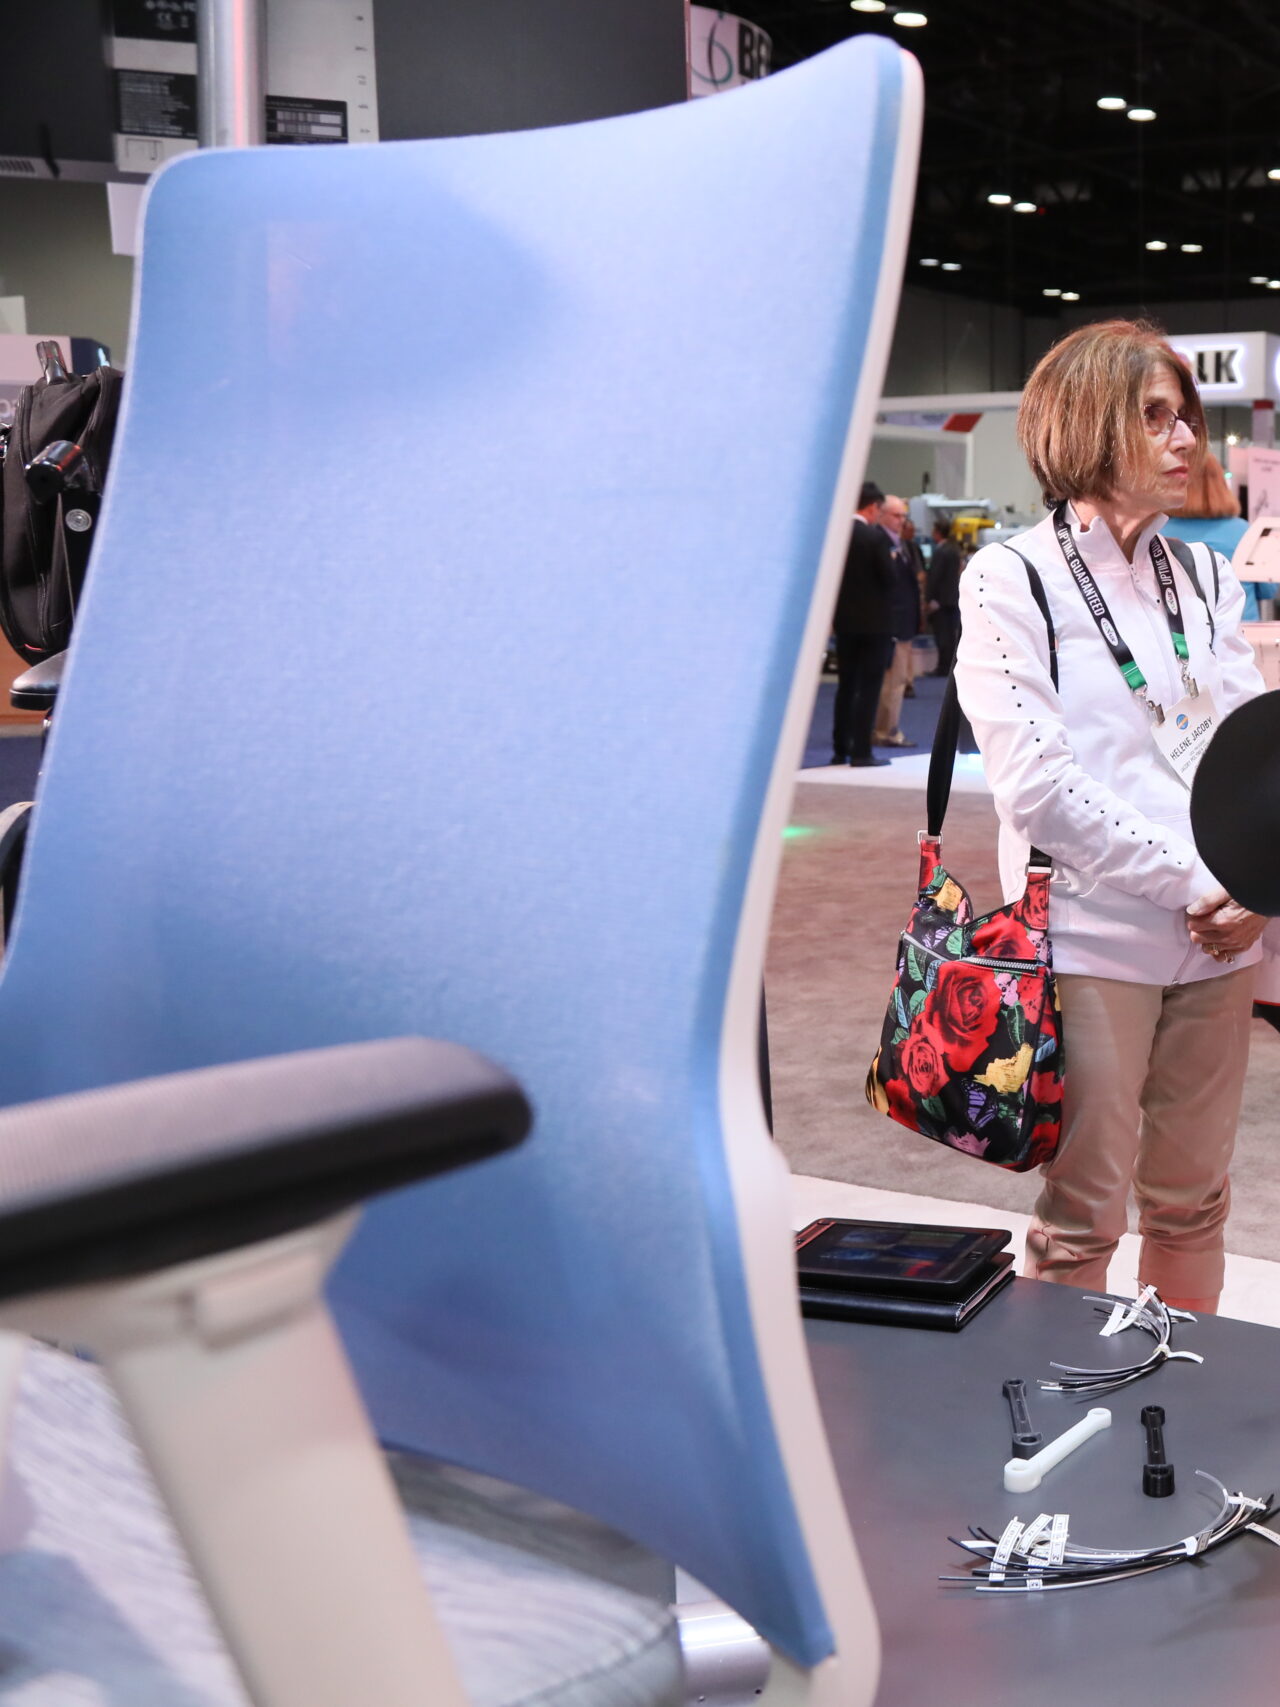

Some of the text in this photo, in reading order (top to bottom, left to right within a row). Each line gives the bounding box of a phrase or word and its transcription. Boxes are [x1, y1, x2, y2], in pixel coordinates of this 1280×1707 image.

[1057, 528, 1075, 561] UPTIME
[1070, 559, 1105, 617] GUARANTEED
[1155, 555, 1172, 585] UPTIME
[1170, 736, 1192, 761] HELENE
[1191, 716, 1213, 741] JACOBY
